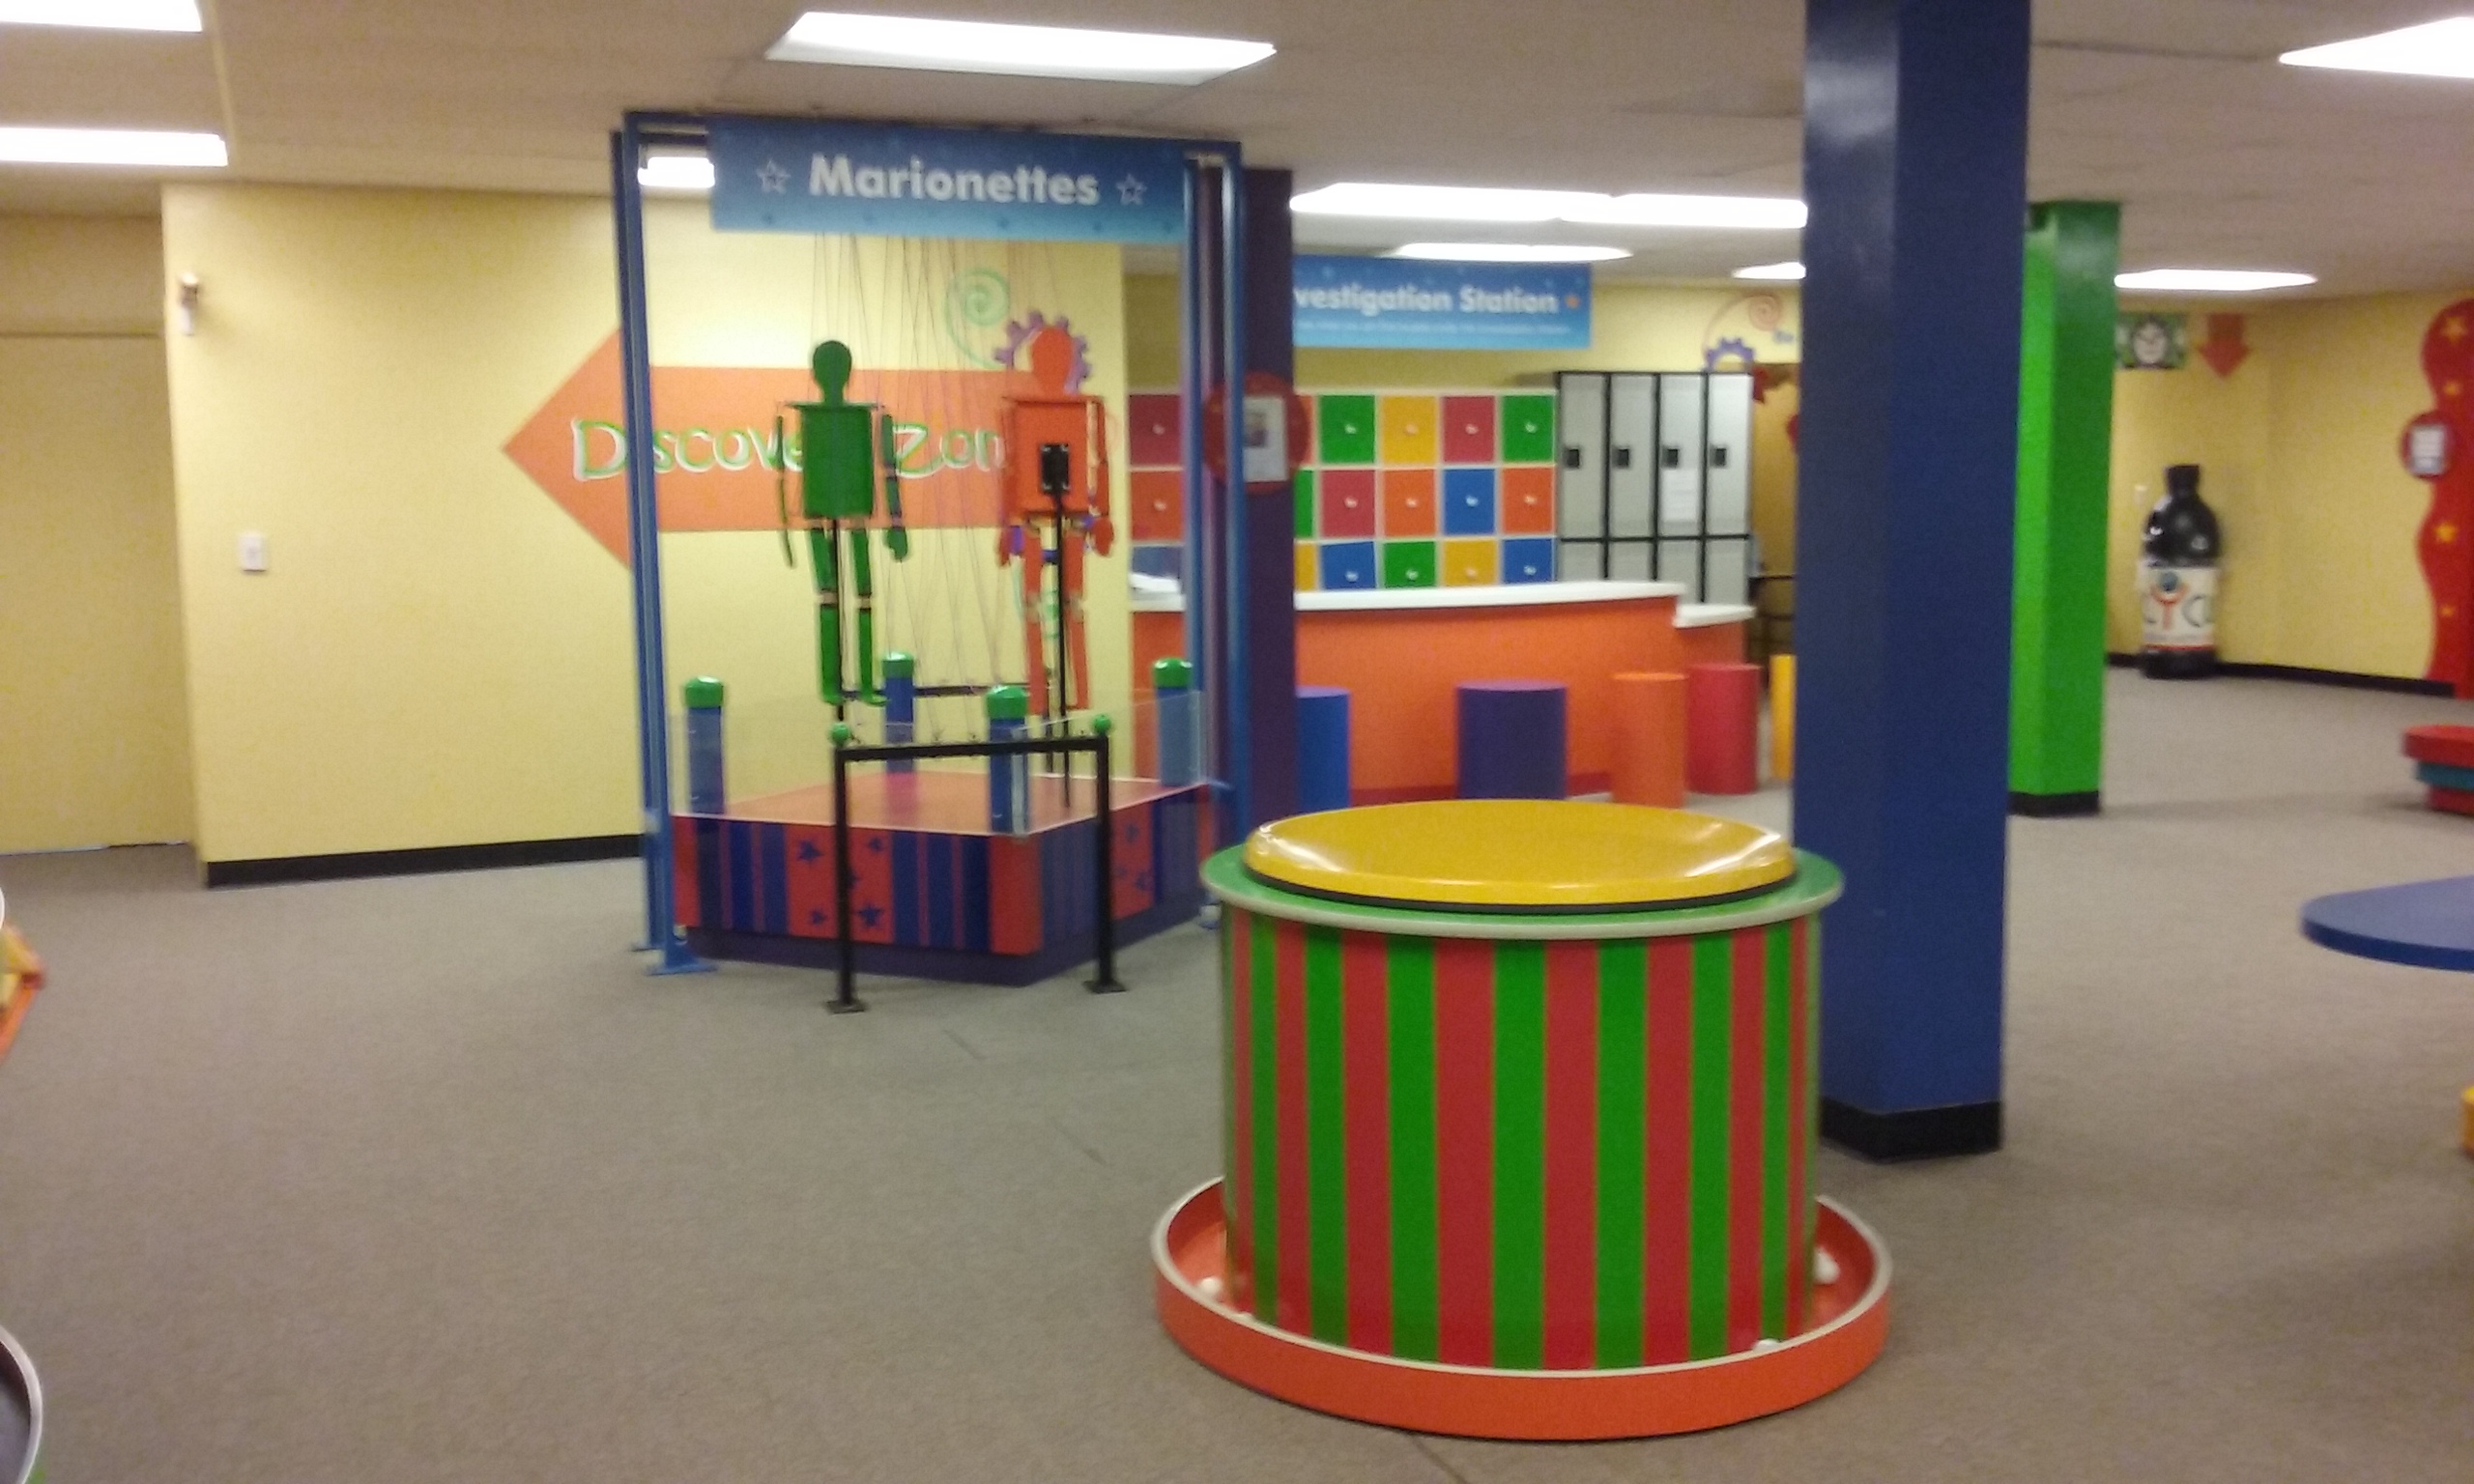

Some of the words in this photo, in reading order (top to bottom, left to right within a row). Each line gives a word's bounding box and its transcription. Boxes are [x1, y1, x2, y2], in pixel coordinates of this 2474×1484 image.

[808, 151, 1101, 207] Marionettes
[1293, 282, 1453, 317] vestigation
[1459, 284, 1560, 314] Station
[570, 417, 804, 481] Dscove
[891, 421, 1005, 479] Zon
